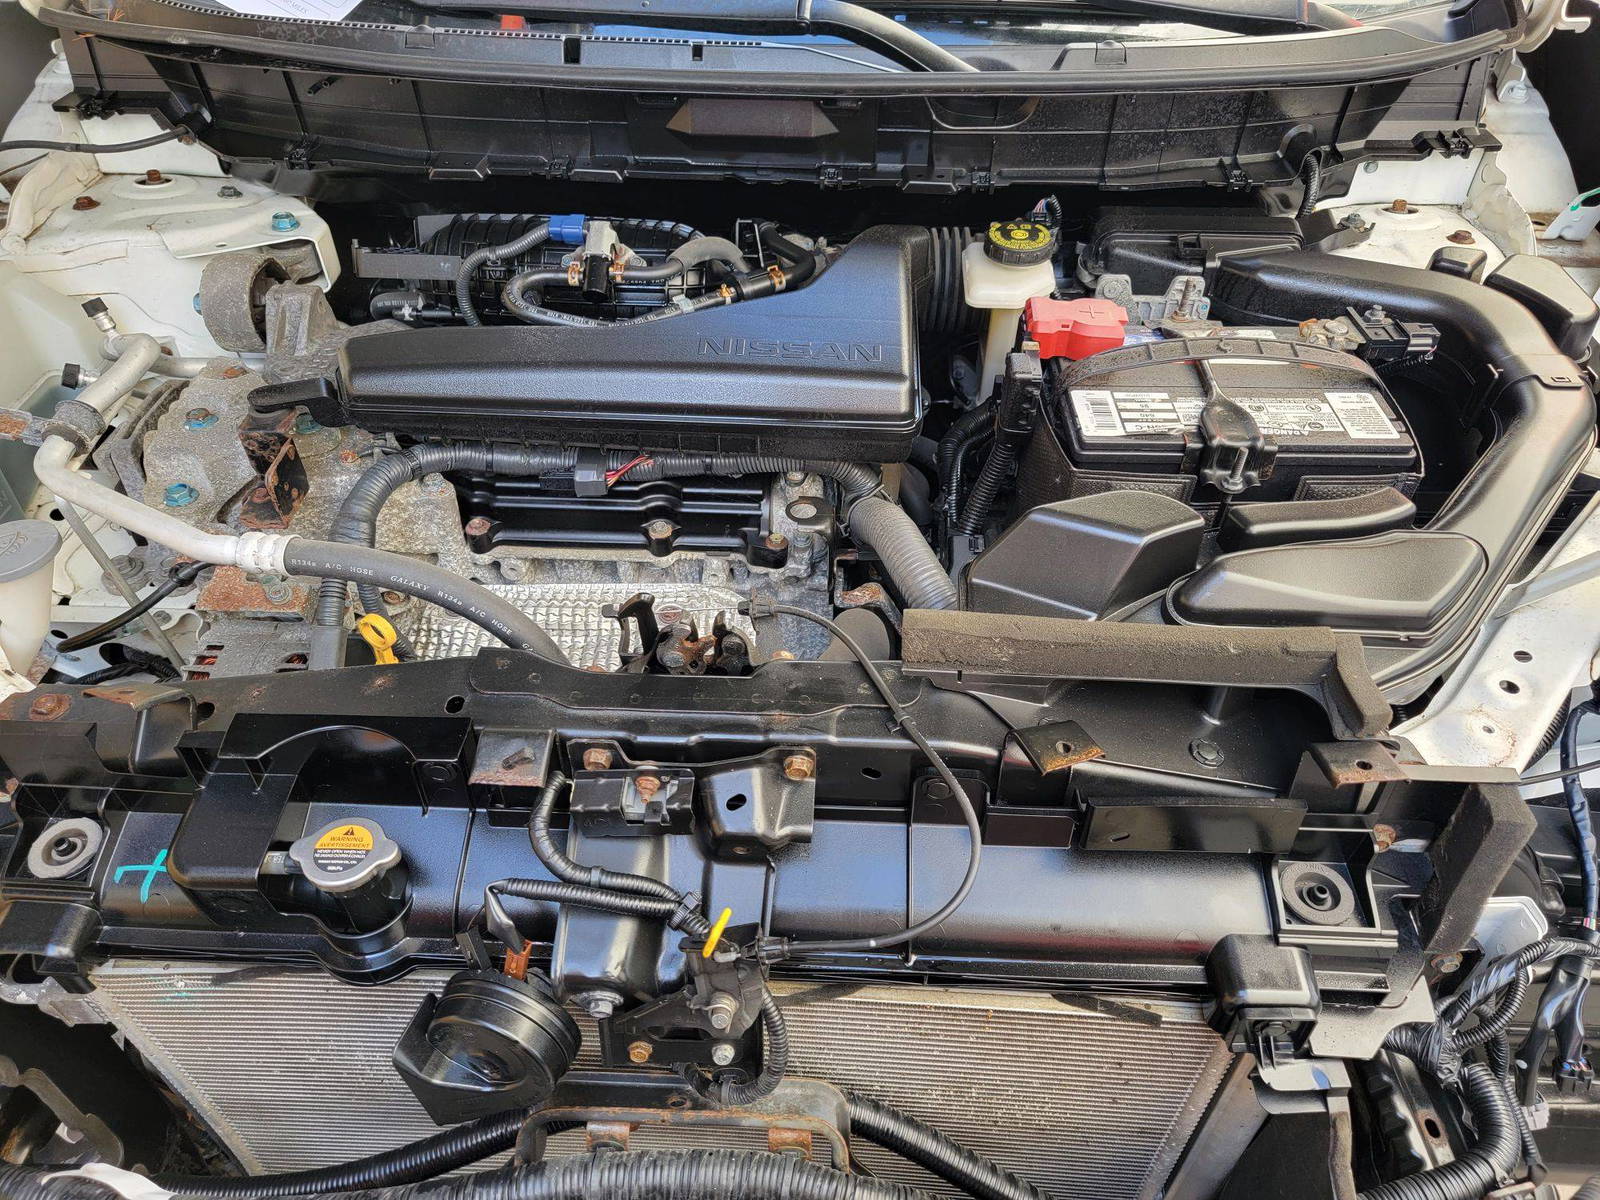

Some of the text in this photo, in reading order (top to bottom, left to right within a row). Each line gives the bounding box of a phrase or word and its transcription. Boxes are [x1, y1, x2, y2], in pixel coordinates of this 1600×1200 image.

[698, 336, 882, 362] NISSAN
[1259, 427, 1301, 436] DANGER
[324, 562, 342, 571] A/C
[350, 566, 374, 576] HOSE
[390, 574, 431, 591] GALAXY
[469, 606, 486, 619] A/C
[491, 618, 513, 635] HOSE
